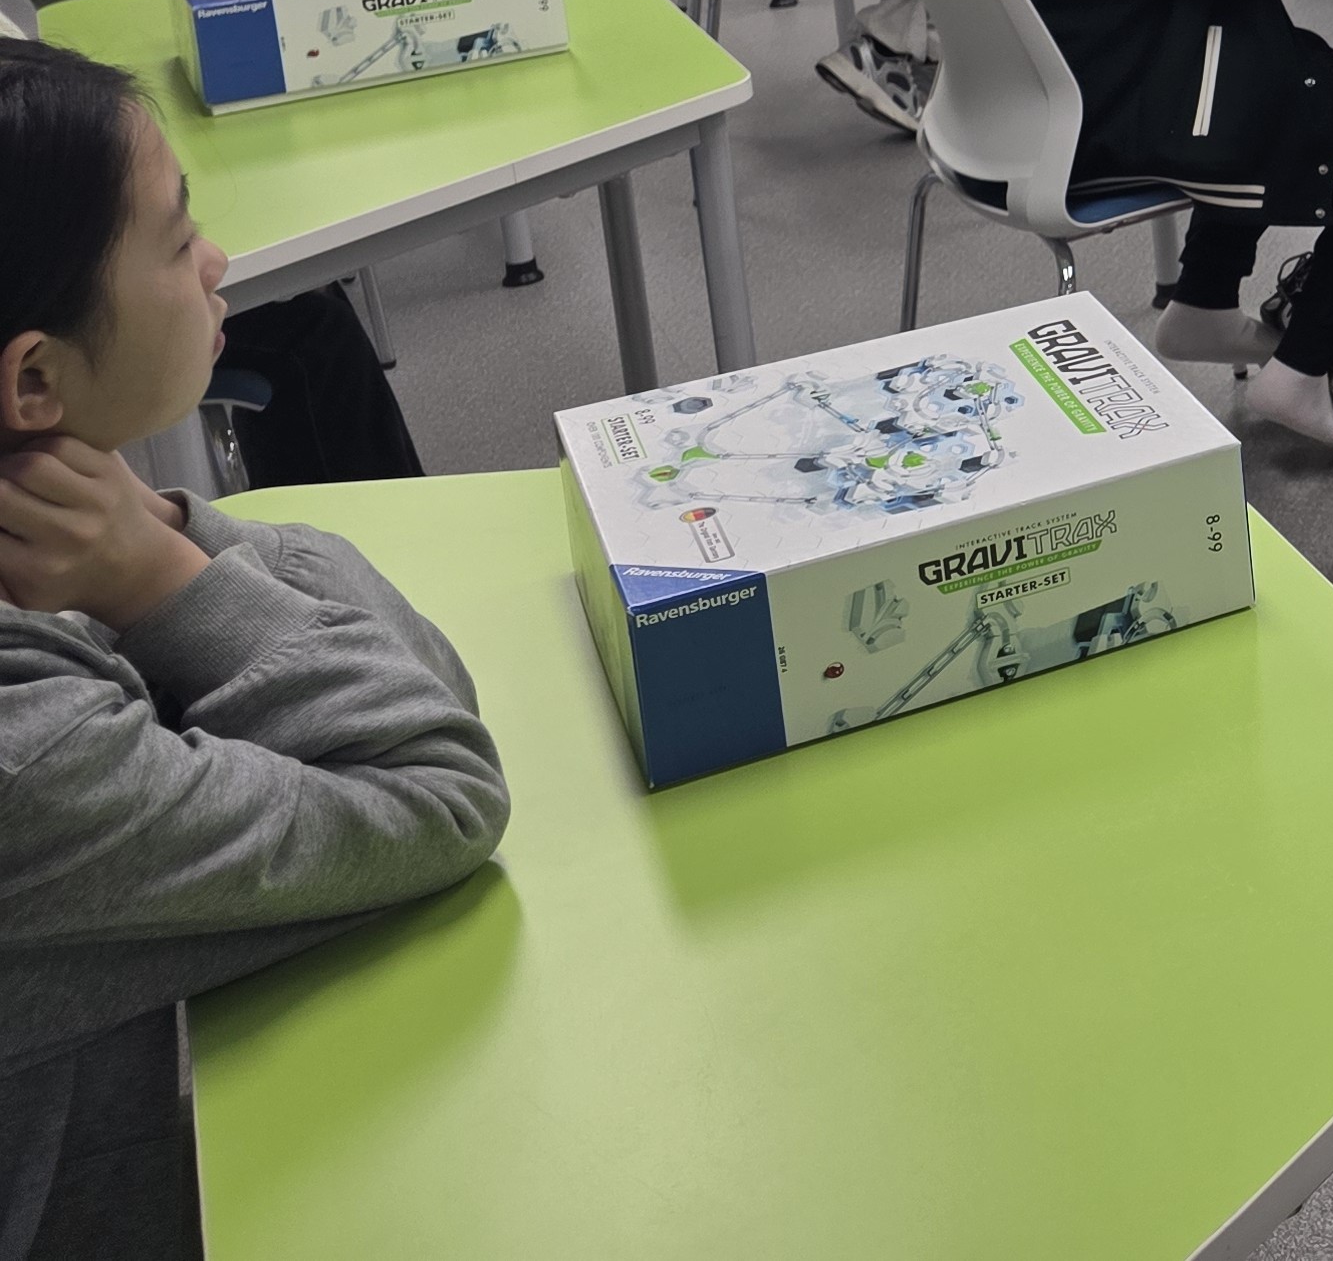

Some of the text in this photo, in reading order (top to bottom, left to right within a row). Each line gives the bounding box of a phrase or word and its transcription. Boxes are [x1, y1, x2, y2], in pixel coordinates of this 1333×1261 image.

[197, 0, 268, 19] Ravensburger
[1028, 319, 1170, 440] GRAVITRAX
[1049, 382, 1069, 402] POWER
[918, 509, 1118, 586] GRAVITRAX
[955, 512, 1078, 551] INTERACTIVE TRACK SYSTEM
[1206, 514, 1223, 552] 8-99
[623, 566, 733, 582] Ravensburger
[943, 543, 1098, 592] EXPERIENCE THE POWER OF GRAVITY
[635, 585, 757, 628] Ravensburger
[979, 571, 1067, 605] STARTER-SET
